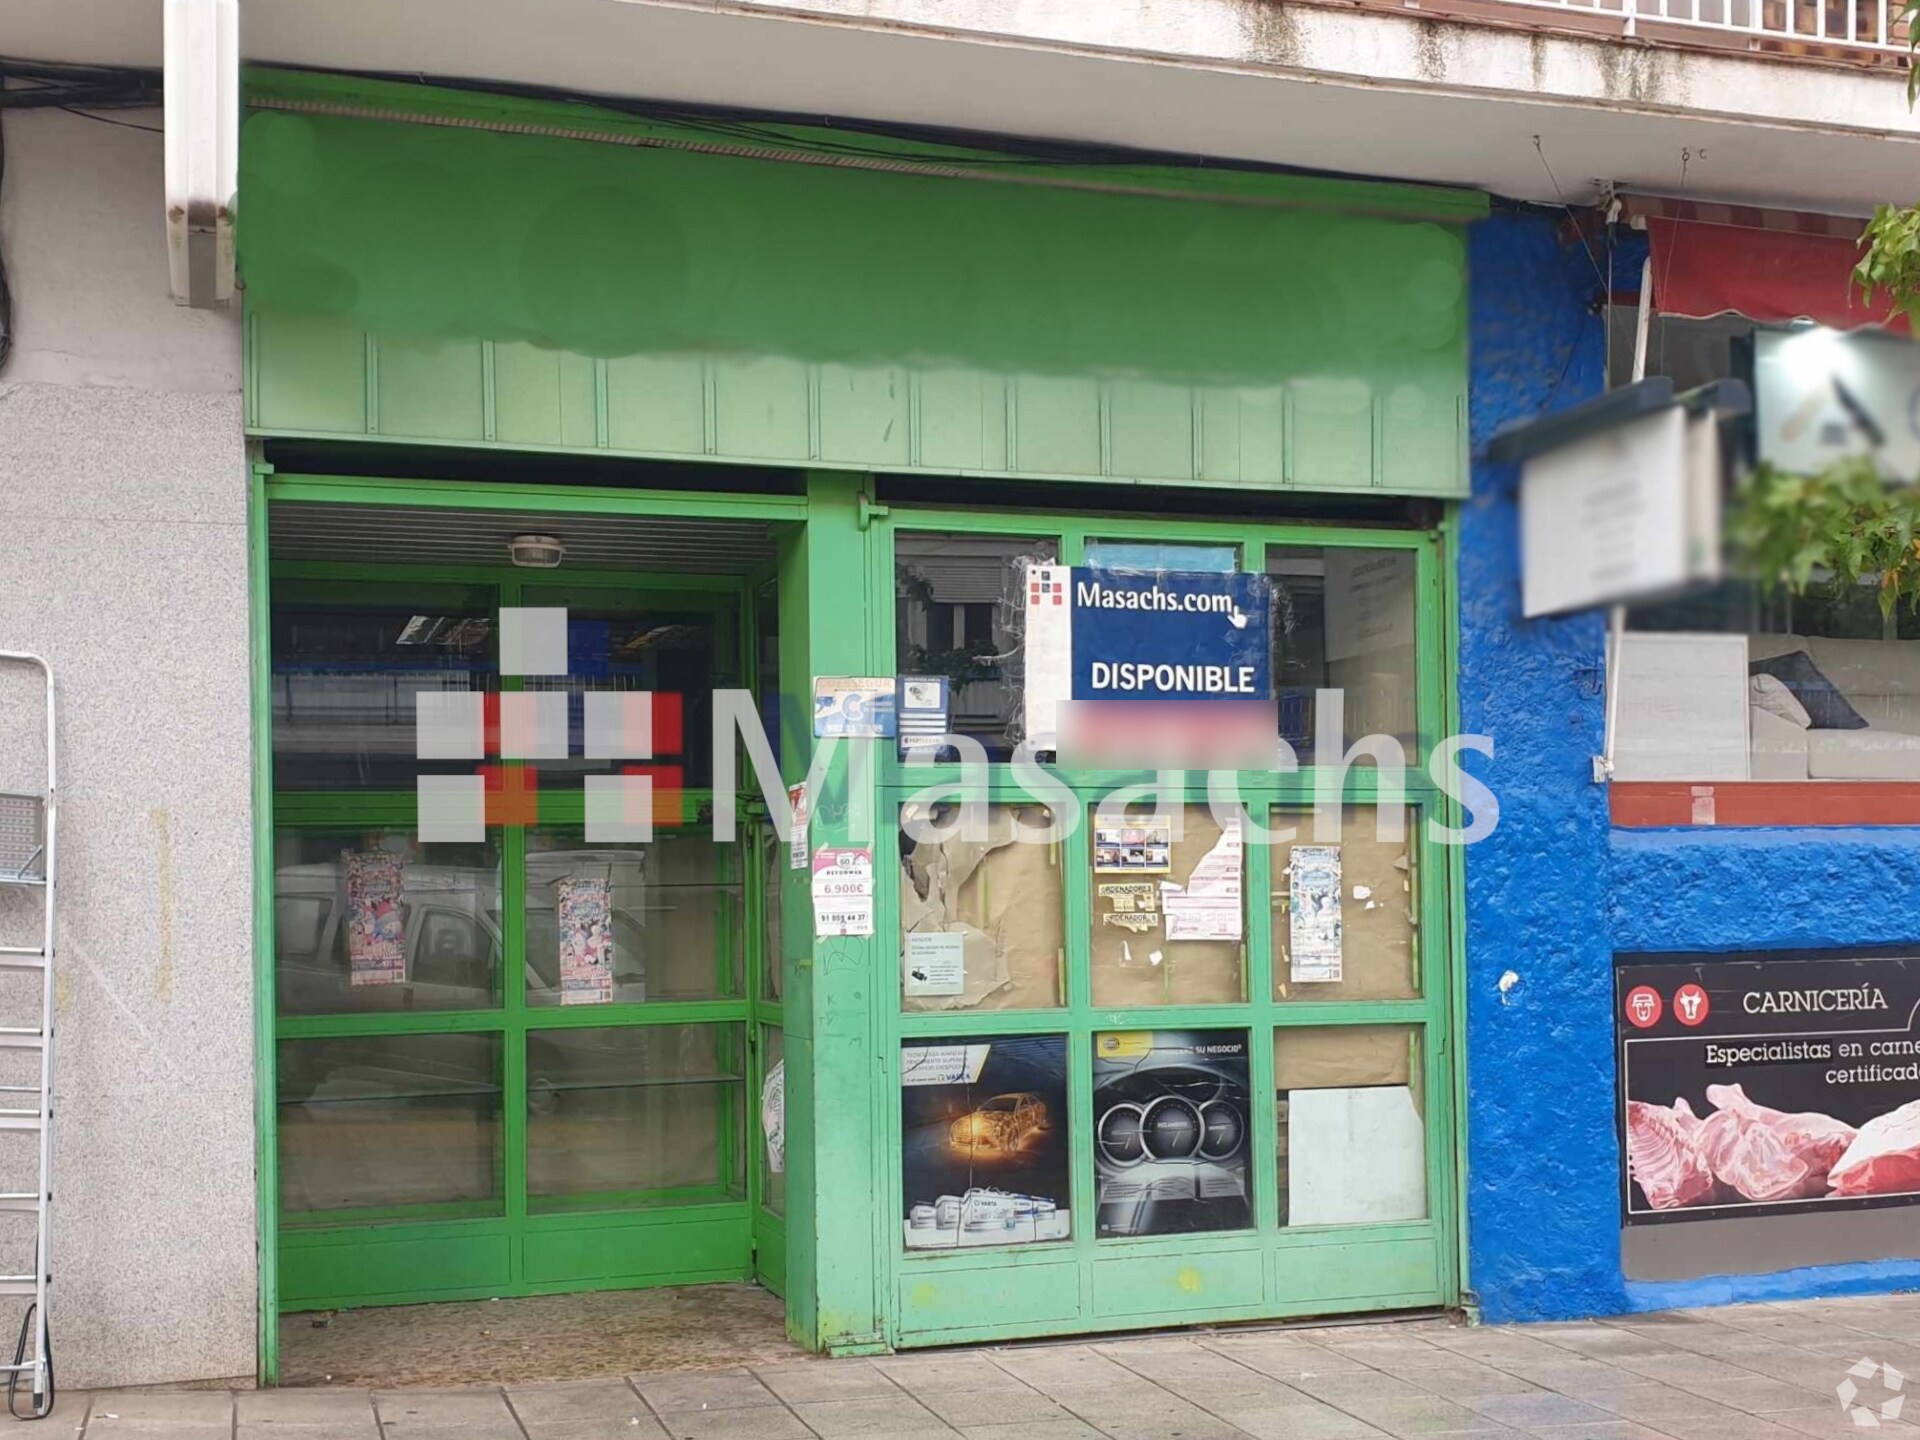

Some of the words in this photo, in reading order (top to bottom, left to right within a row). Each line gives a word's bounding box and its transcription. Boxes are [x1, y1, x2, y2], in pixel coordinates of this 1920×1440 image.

[1077, 581, 1232, 612] Masachs.com
[1091, 662, 1255, 693] DISPONIBLE
[1743, 982, 1888, 1014] CARNICERÍA
[1195, 1045, 1205, 1054] SU
[1705, 1041, 1832, 1067] Especialistas
[1838, 1042, 1863, 1057] en
[1825, 1062, 1920, 1084] certificad
